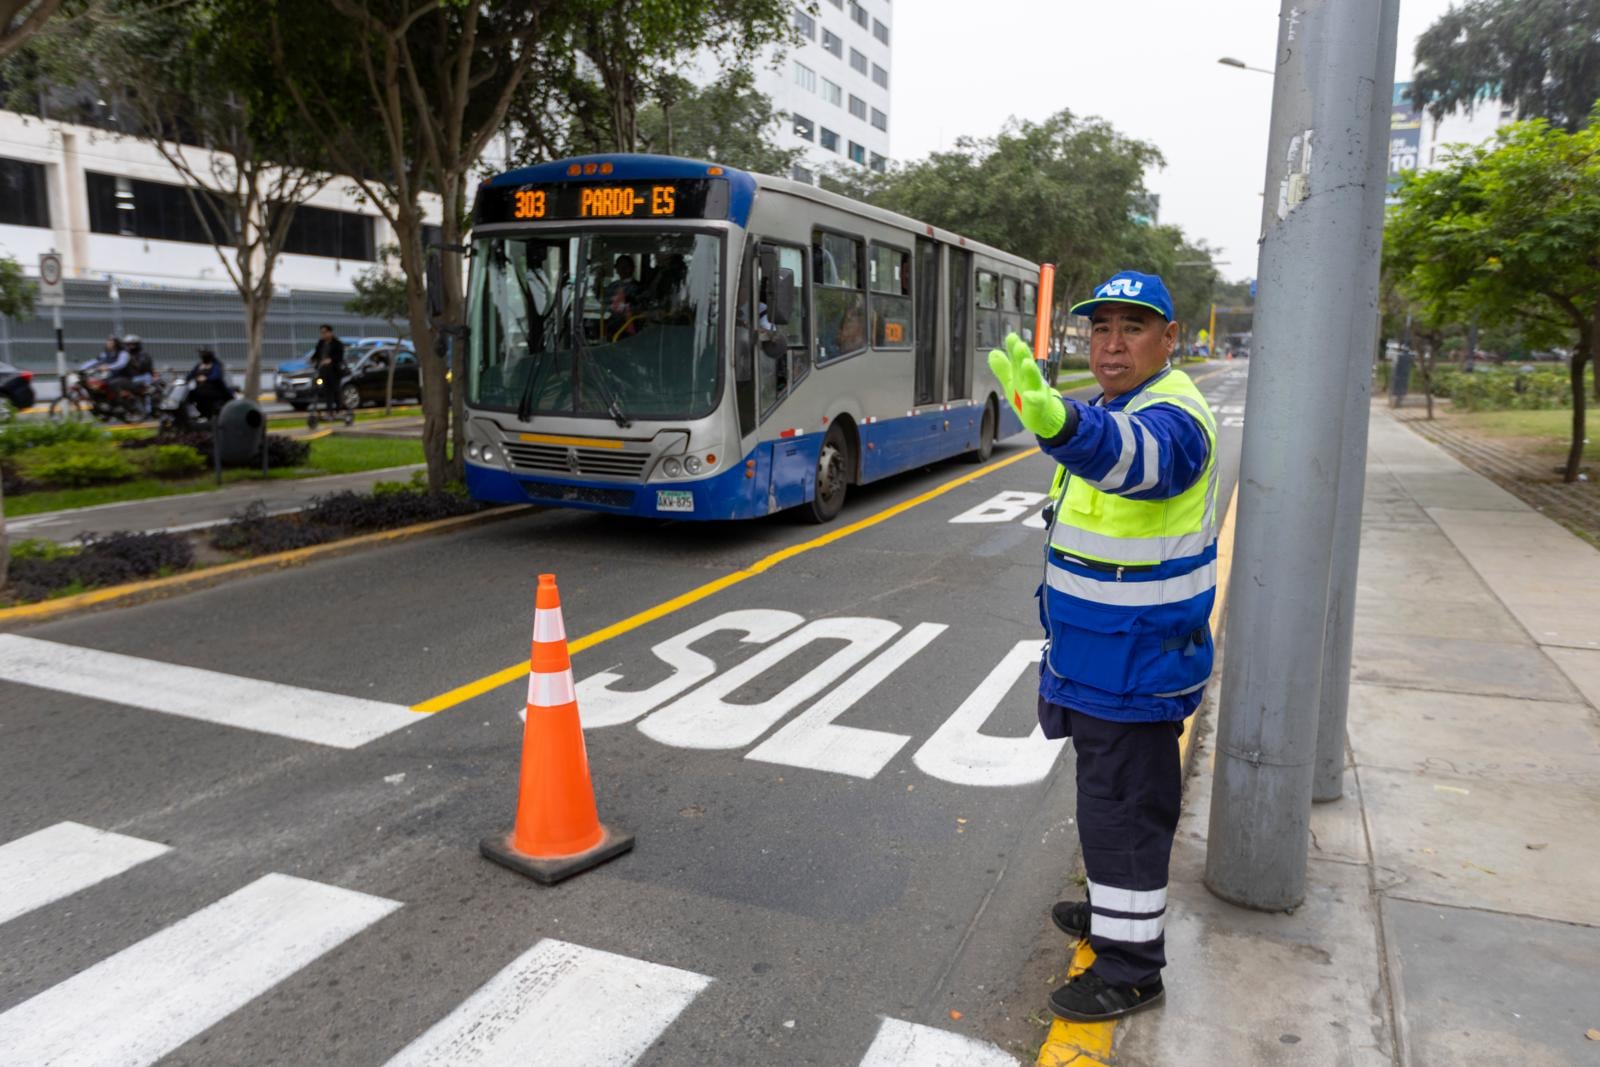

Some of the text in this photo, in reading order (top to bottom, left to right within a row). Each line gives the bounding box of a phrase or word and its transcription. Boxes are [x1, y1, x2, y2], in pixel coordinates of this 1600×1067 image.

[514, 186, 676, 217] 303 PARDO- ES
[1096, 279, 1143, 298] ATU
[518, 608, 1070, 787] SOLO
